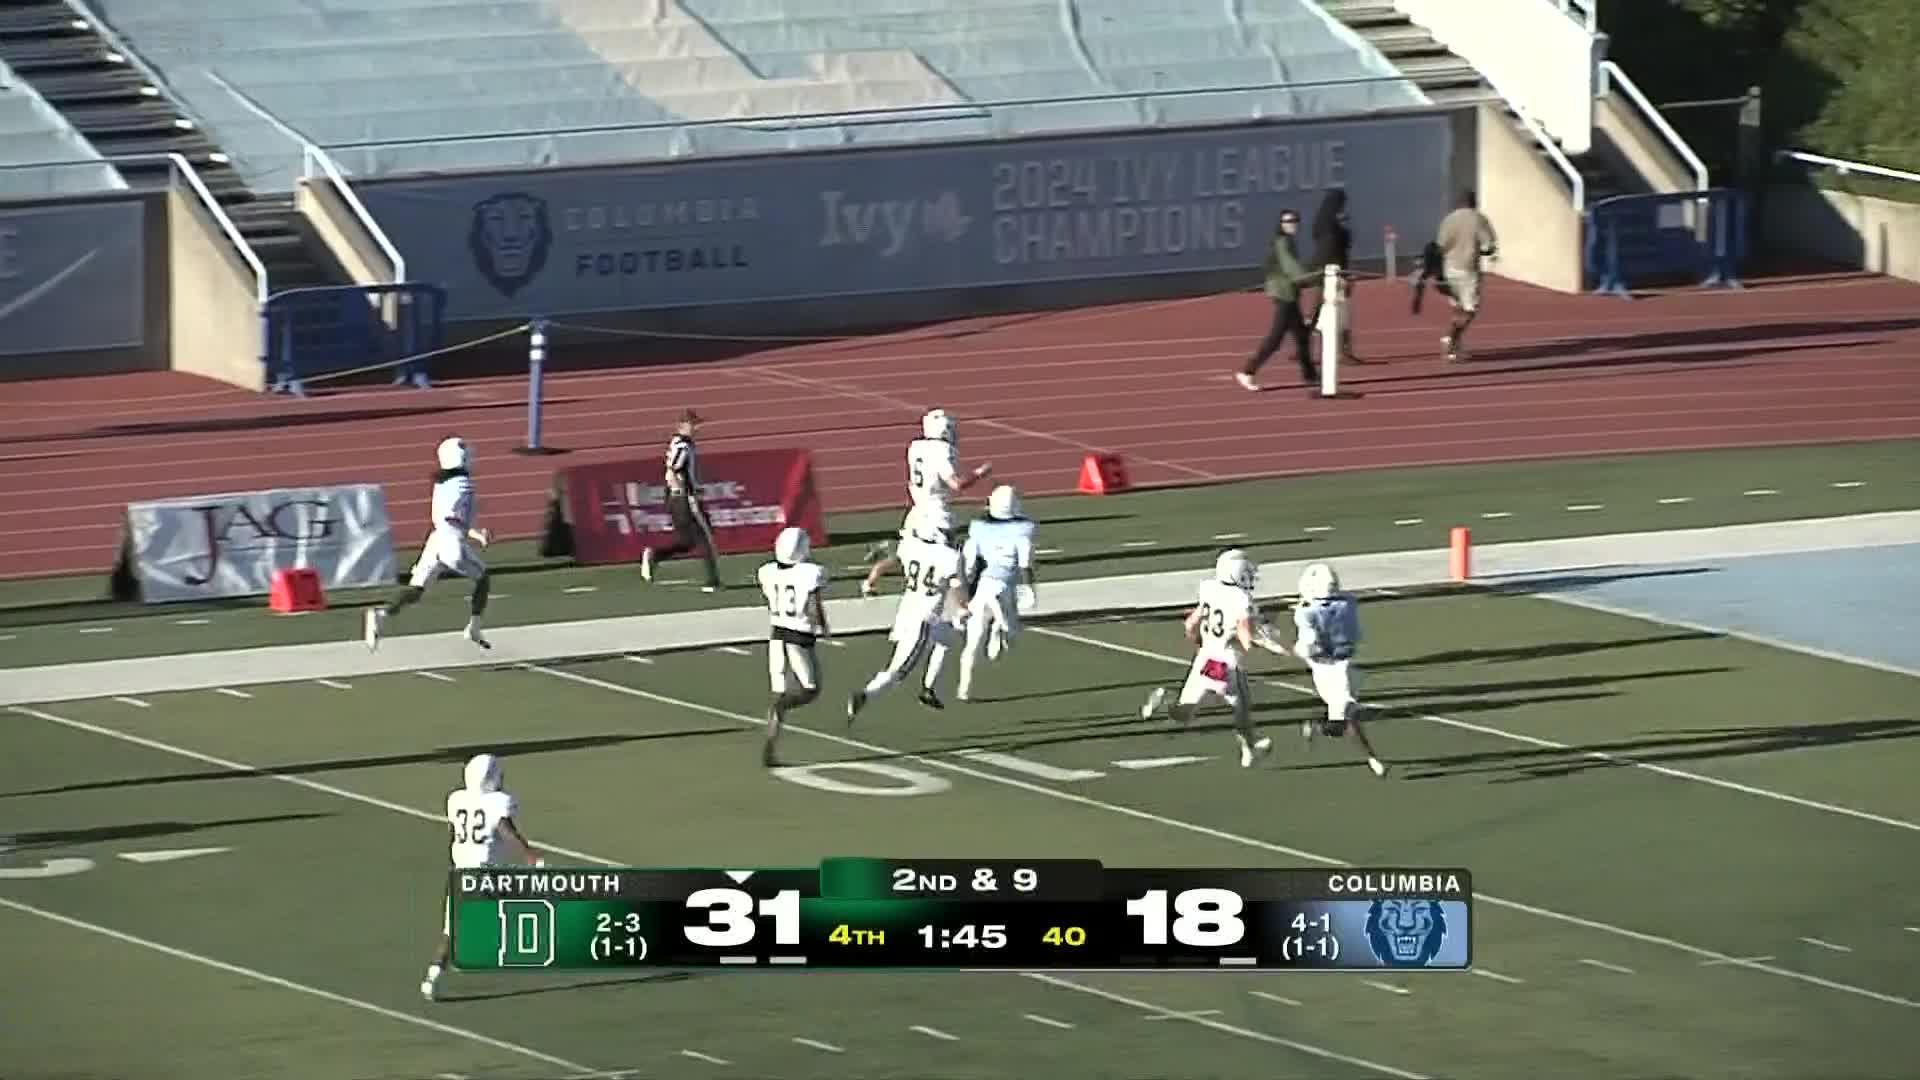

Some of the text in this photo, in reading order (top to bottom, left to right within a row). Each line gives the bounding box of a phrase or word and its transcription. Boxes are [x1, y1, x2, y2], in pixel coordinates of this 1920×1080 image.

[993, 140, 1346, 210] 2024 IVY LEAGUE
[563, 197, 760, 231] COLUMBIA
[818, 190, 916, 257] Ivy
[993, 200, 1246, 265] CHAMPIONS
[575, 243, 749, 277] FOOTBALL
[184, 500, 342, 586] JAG
[770, 583, 797, 618] 13
[455, 808, 488, 844] 32
